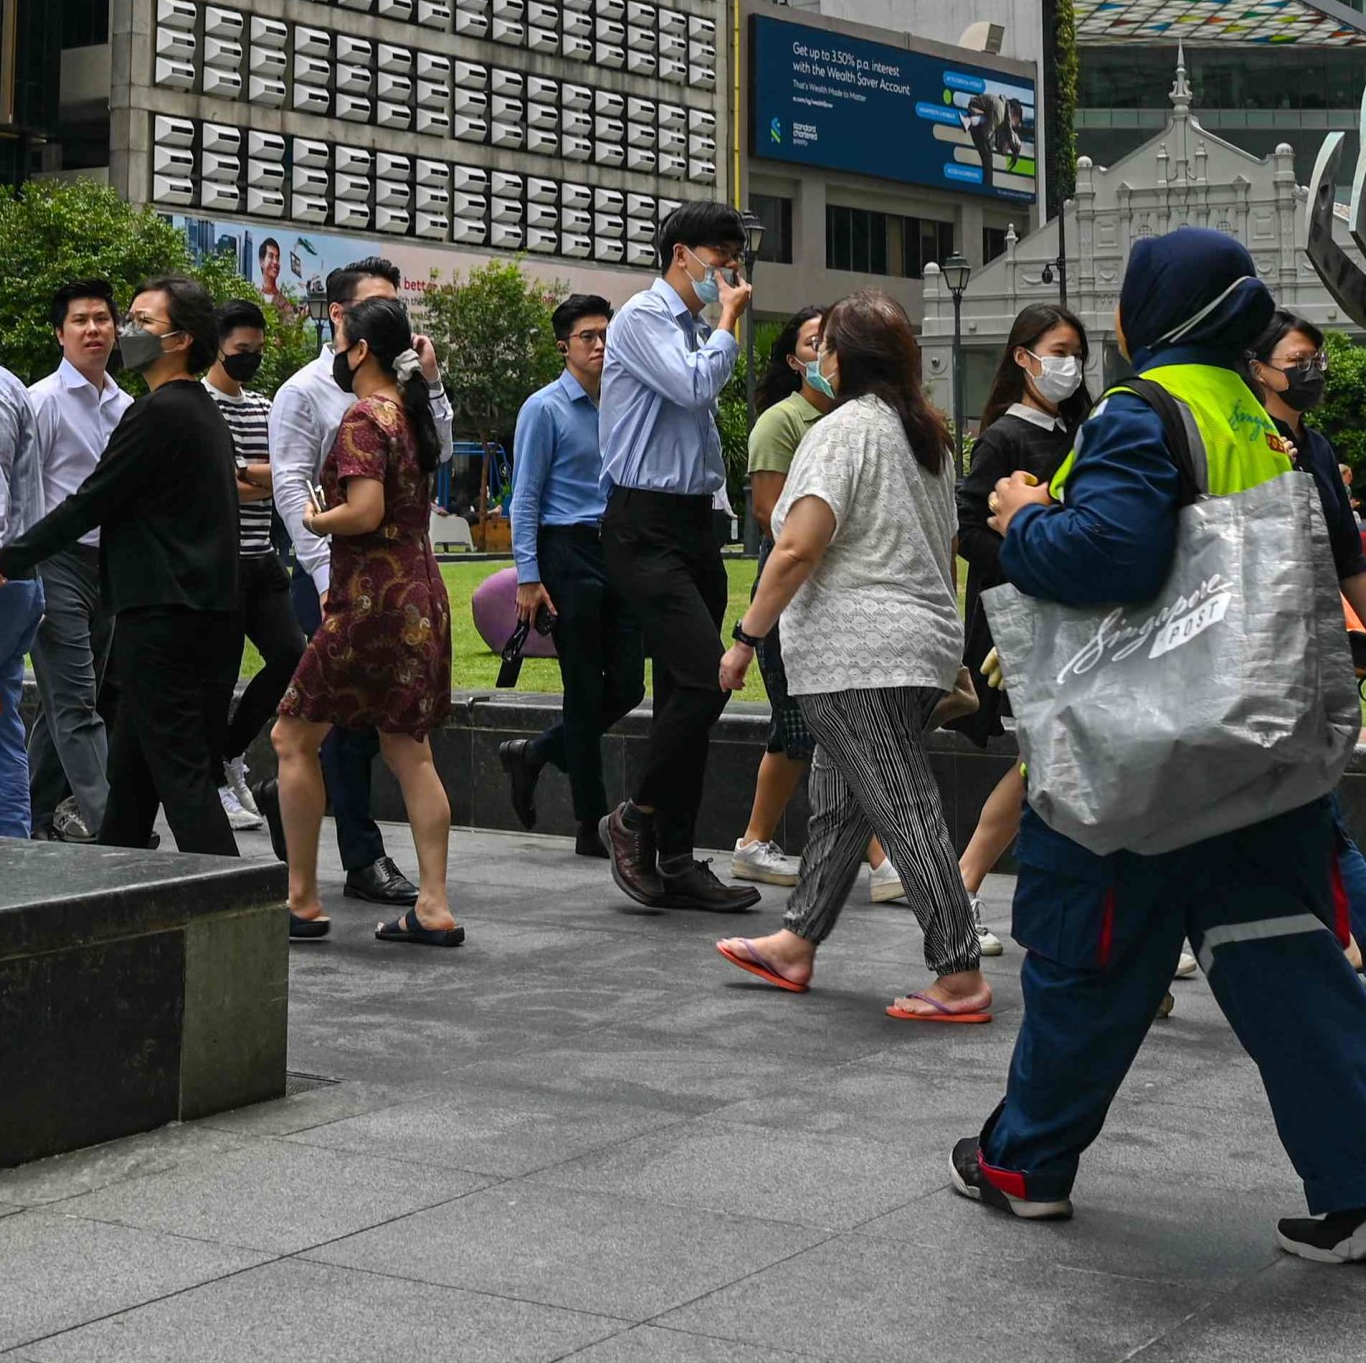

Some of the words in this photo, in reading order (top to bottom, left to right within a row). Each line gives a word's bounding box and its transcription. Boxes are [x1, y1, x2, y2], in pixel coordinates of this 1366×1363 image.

[792, 41, 808, 57] Get
[809, 49, 820, 60] up
[821, 50, 830, 60] to
[831, 50, 855, 67] 3.50%
[872, 58, 900, 77] interest
[792, 61, 811, 74] with
[812, 64, 825, 77] the
[827, 66, 856, 83] Wealth
[879, 78, 911, 96] Account
[1057, 574, 1235, 684] Singapore
[1168, 599, 1219, 646] POST
